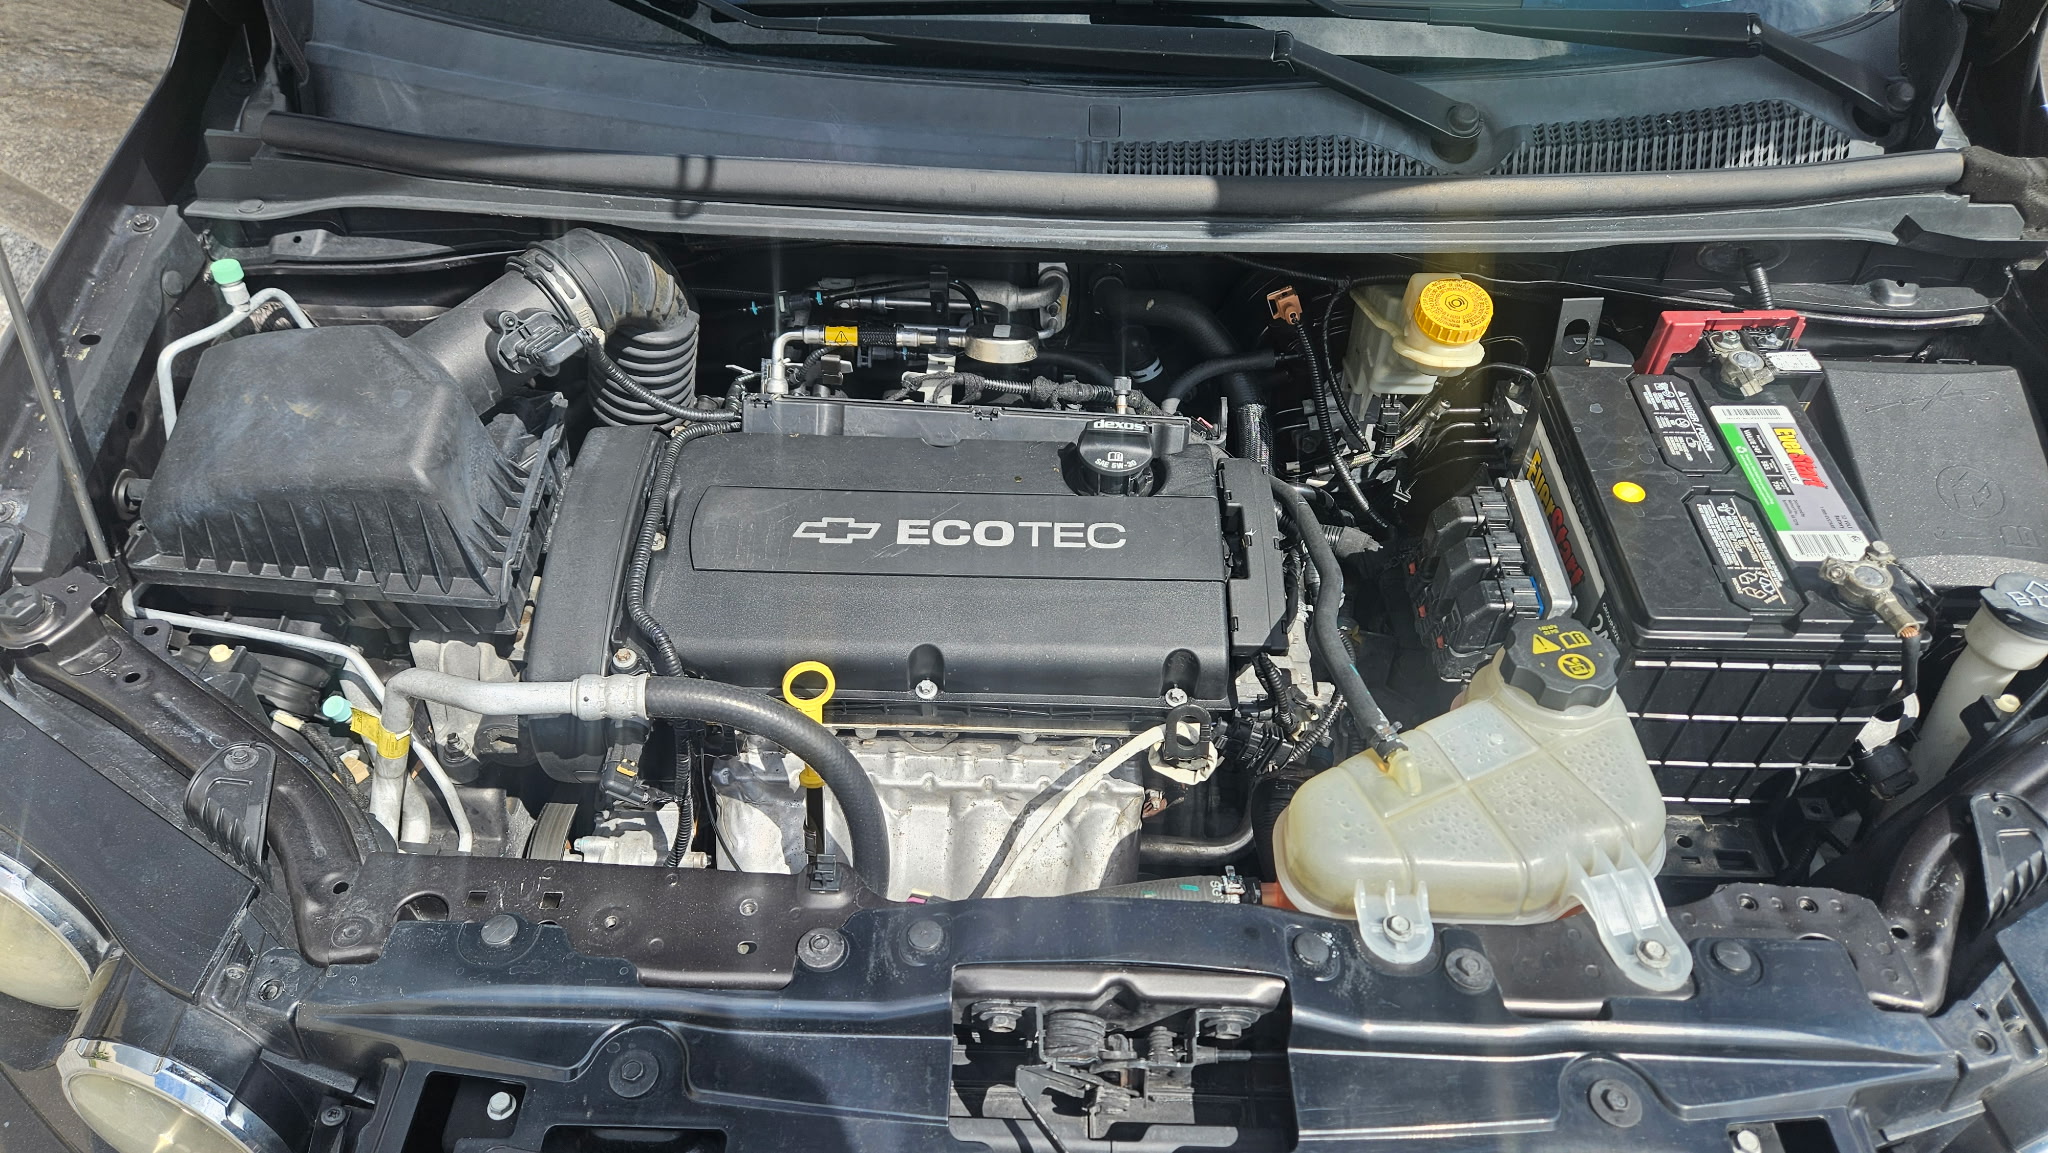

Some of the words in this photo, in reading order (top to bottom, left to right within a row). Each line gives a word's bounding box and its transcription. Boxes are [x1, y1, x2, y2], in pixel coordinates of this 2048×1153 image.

[1093, 419, 1147, 431] dexos
[1681, 397, 1699, 422] DANGER
[1696, 427, 1715, 451] POISON
[1095, 458, 1109, 468] SAE
[1111, 460, 1137, 469] 5W-30
[1773, 427, 1828, 488] EverStart
[897, 519, 1127, 549] ECOTEC
